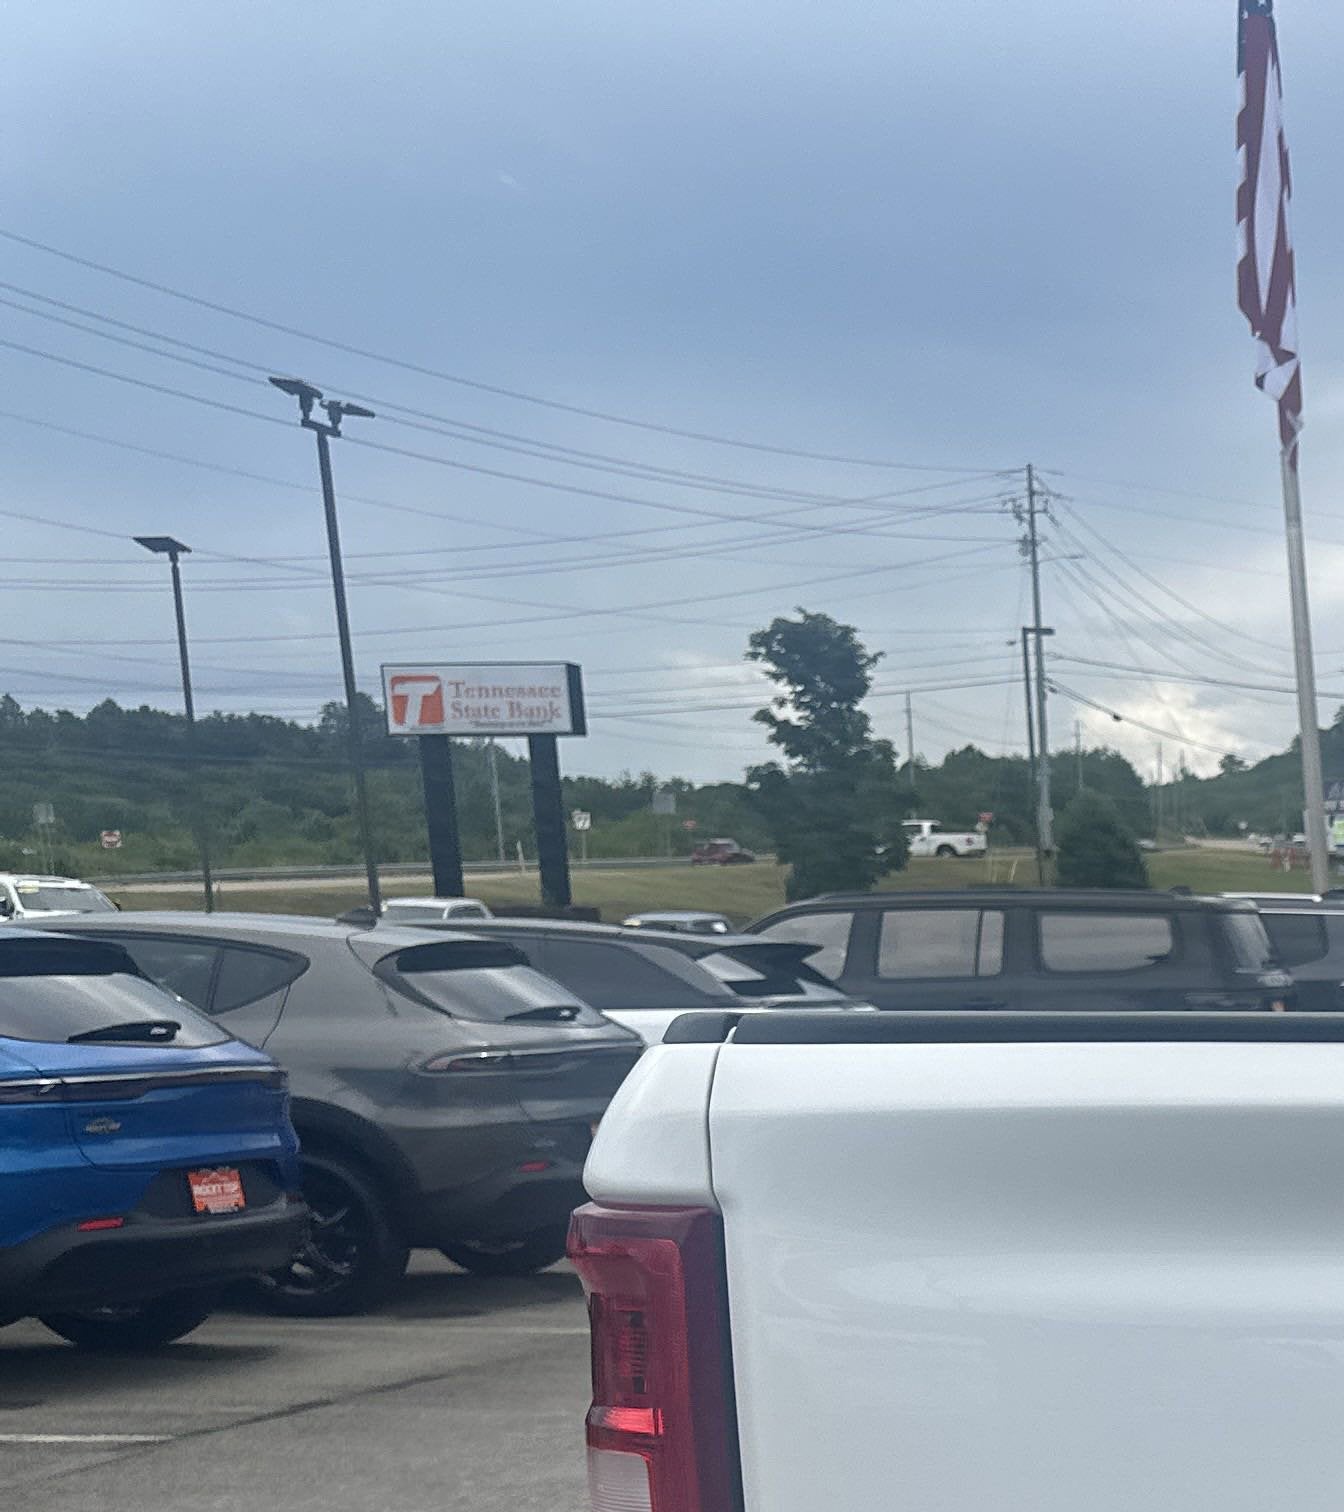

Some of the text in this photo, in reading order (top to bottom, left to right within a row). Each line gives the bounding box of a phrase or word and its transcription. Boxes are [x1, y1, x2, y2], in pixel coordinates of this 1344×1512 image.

[447, 680, 562, 698] Tennessee
[450, 699, 562, 721] State Bank
